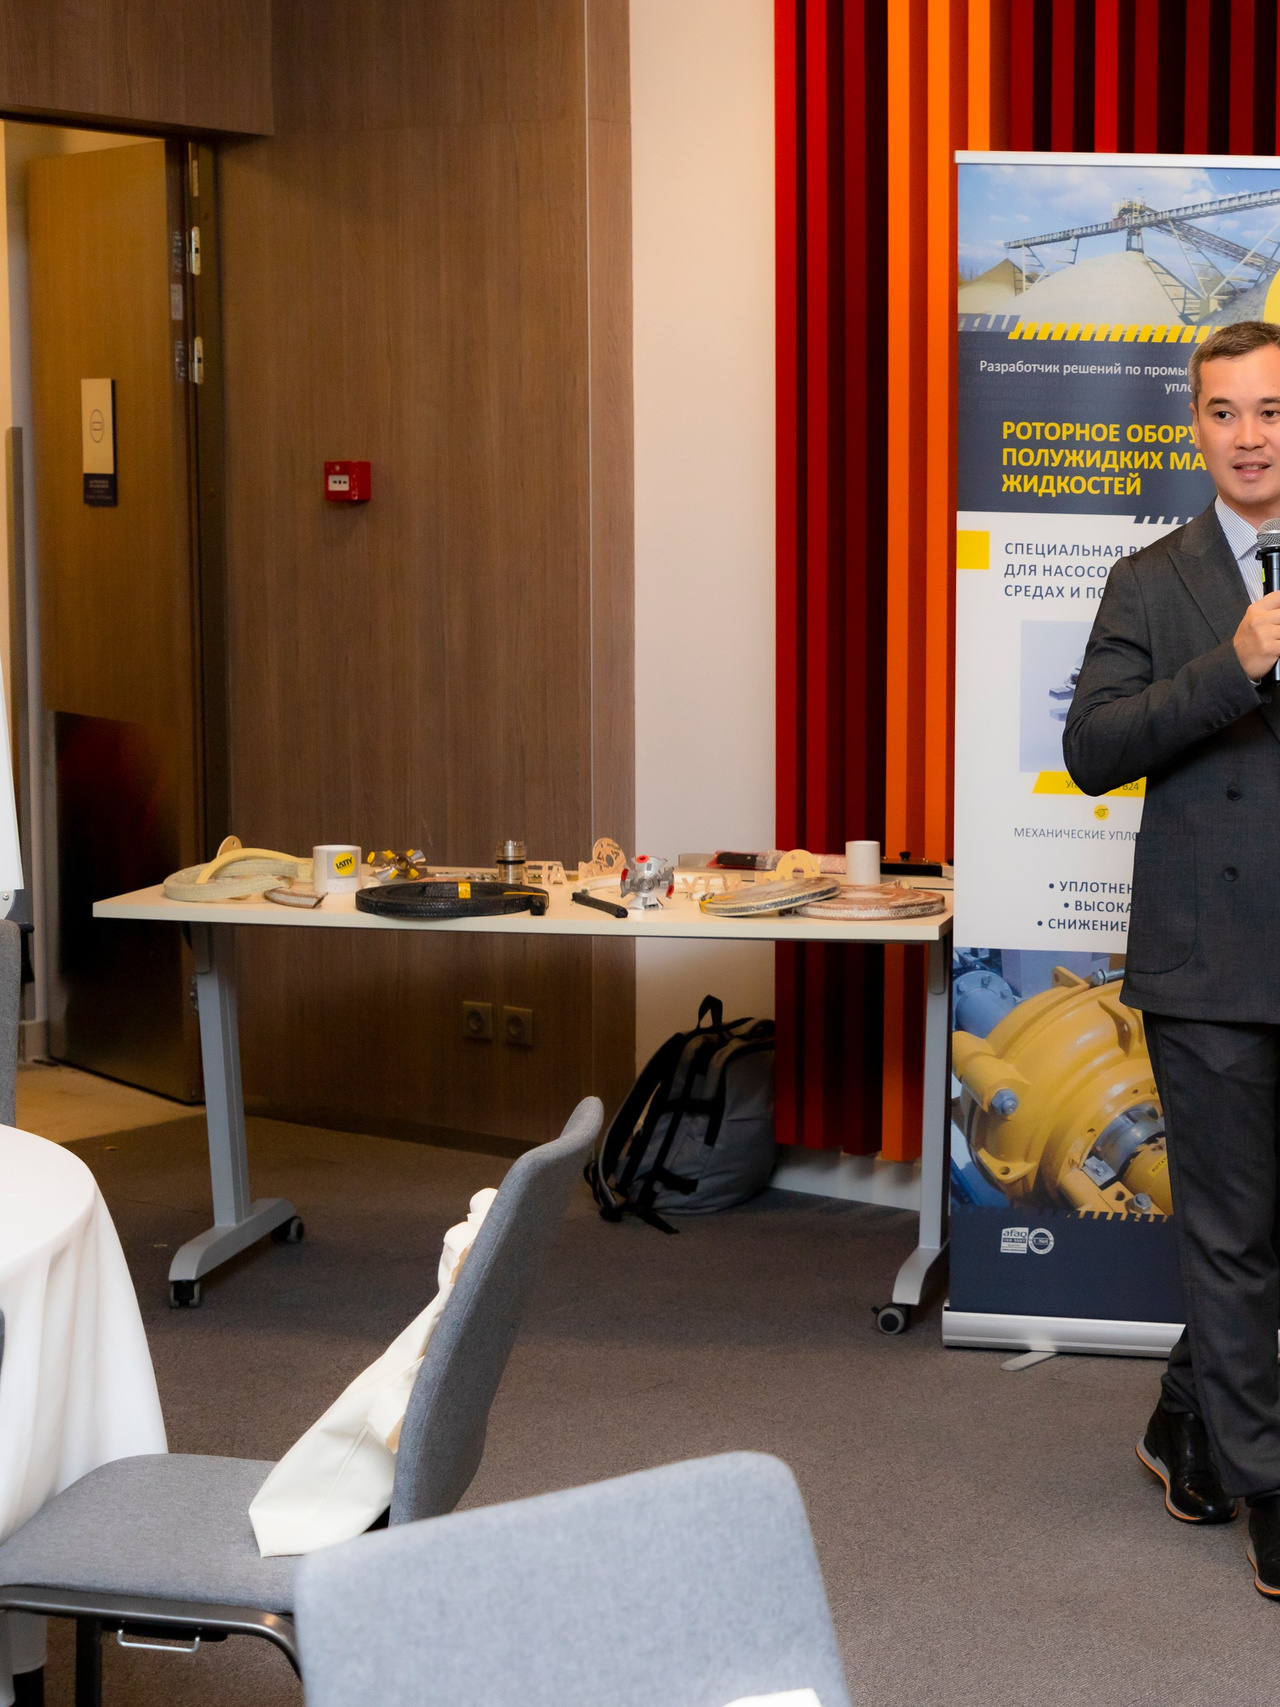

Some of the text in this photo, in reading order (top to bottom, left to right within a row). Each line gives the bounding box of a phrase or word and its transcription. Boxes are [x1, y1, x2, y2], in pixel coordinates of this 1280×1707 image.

[979, 360, 1188, 377] Разработчик решений по промы
[1002, 421, 1121, 443] РОТОРНОЕ
[1126, 424, 1196, 444] ОБОРУ
[1002, 448, 1164, 472] ПОЛУЖИДКИХ
[1170, 452, 1208, 471] МА
[1001, 473, 1142, 497] ЖИДКОСТЕЙ
[1004, 543, 1124, 558] СПЕЦИАЛЬНАЯ
[1004, 564, 1112, 578] ДЛЯ НАСОСО
[1004, 585, 1065, 600] СРЕДАХ
[1070, 586, 1081, 598] И
[1014, 828, 1137, 841] МЕХАНИЧЕСКИЕ УПЛО
[1060, 881, 1133, 894] УПЛОТНЕН
[1074, 900, 1132, 913] ВЫСОКА
[1048, 918, 1128, 933] СНИЖЕНИЕ
